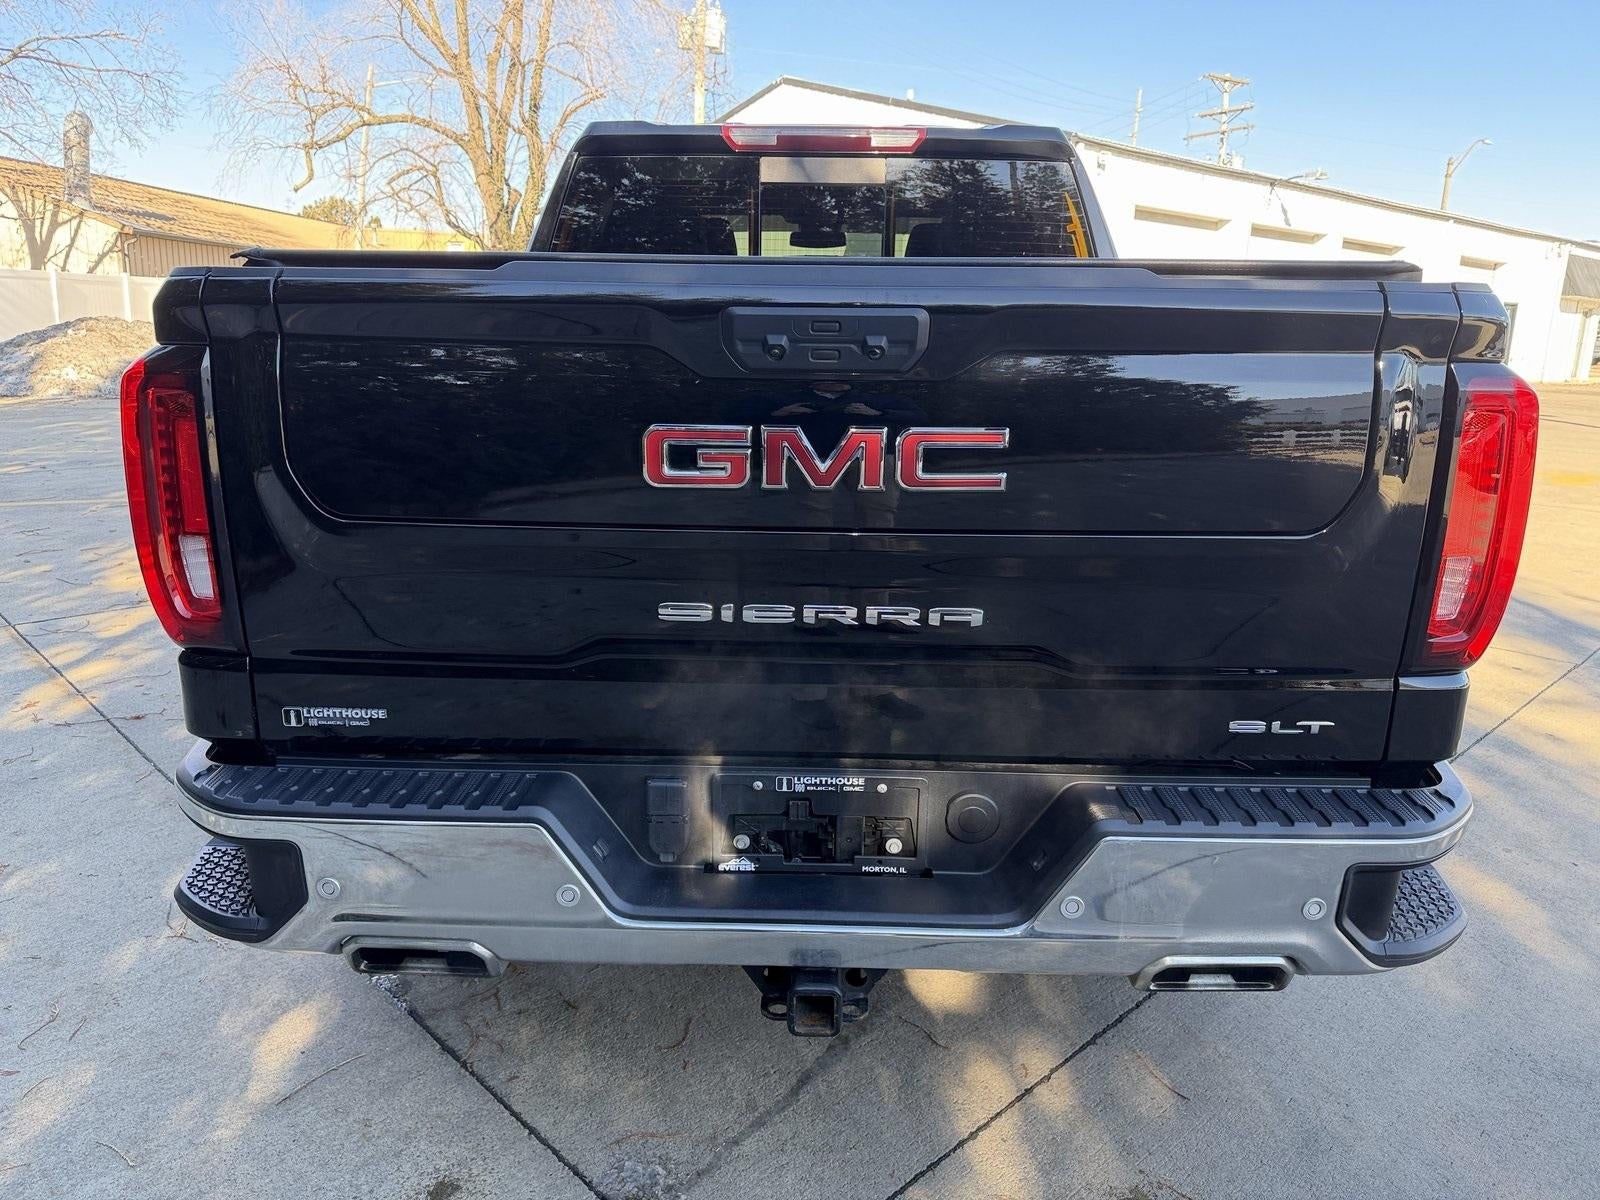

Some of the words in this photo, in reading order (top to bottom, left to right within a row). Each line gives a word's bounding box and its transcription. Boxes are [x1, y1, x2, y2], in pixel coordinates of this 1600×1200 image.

[643, 424, 1010, 492] GMC
[657, 602, 984, 626] SIERRA
[303, 708, 387, 719] LIGHTHOUSE
[350, 719, 370, 727] GMC
[1228, 720, 1335, 734] SLT
[794, 777, 865, 785] LIGHTHOUSE
[718, 863, 756, 871] everest
[862, 866, 898, 874] MORTON,
